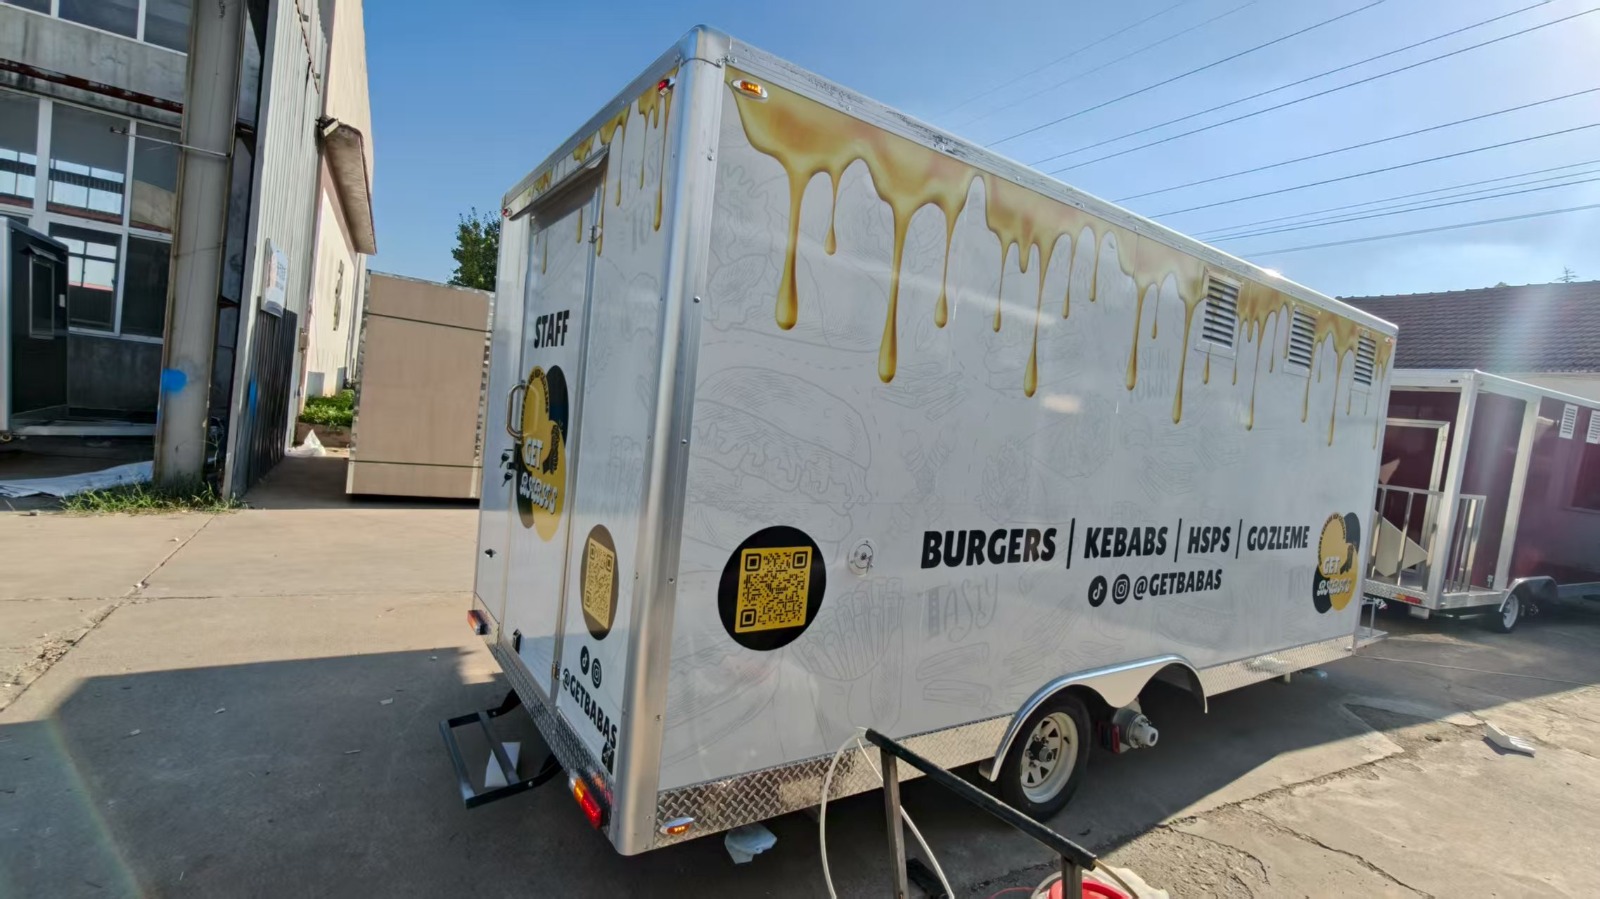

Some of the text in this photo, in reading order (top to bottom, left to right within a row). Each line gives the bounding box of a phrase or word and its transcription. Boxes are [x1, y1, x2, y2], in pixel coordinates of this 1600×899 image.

[534, 310, 570, 349] STAFF
[920, 528, 1057, 569] BURGERS
[1083, 526, 1168, 559] KEBABS
[1187, 526, 1231, 554] HSPS
[1246, 525, 1310, 551] GOZLEME
[1133, 568, 1222, 601] @GETBABAS
[917, 572, 999, 643] TASTY
[562, 667, 618, 750] @GETBABAS
